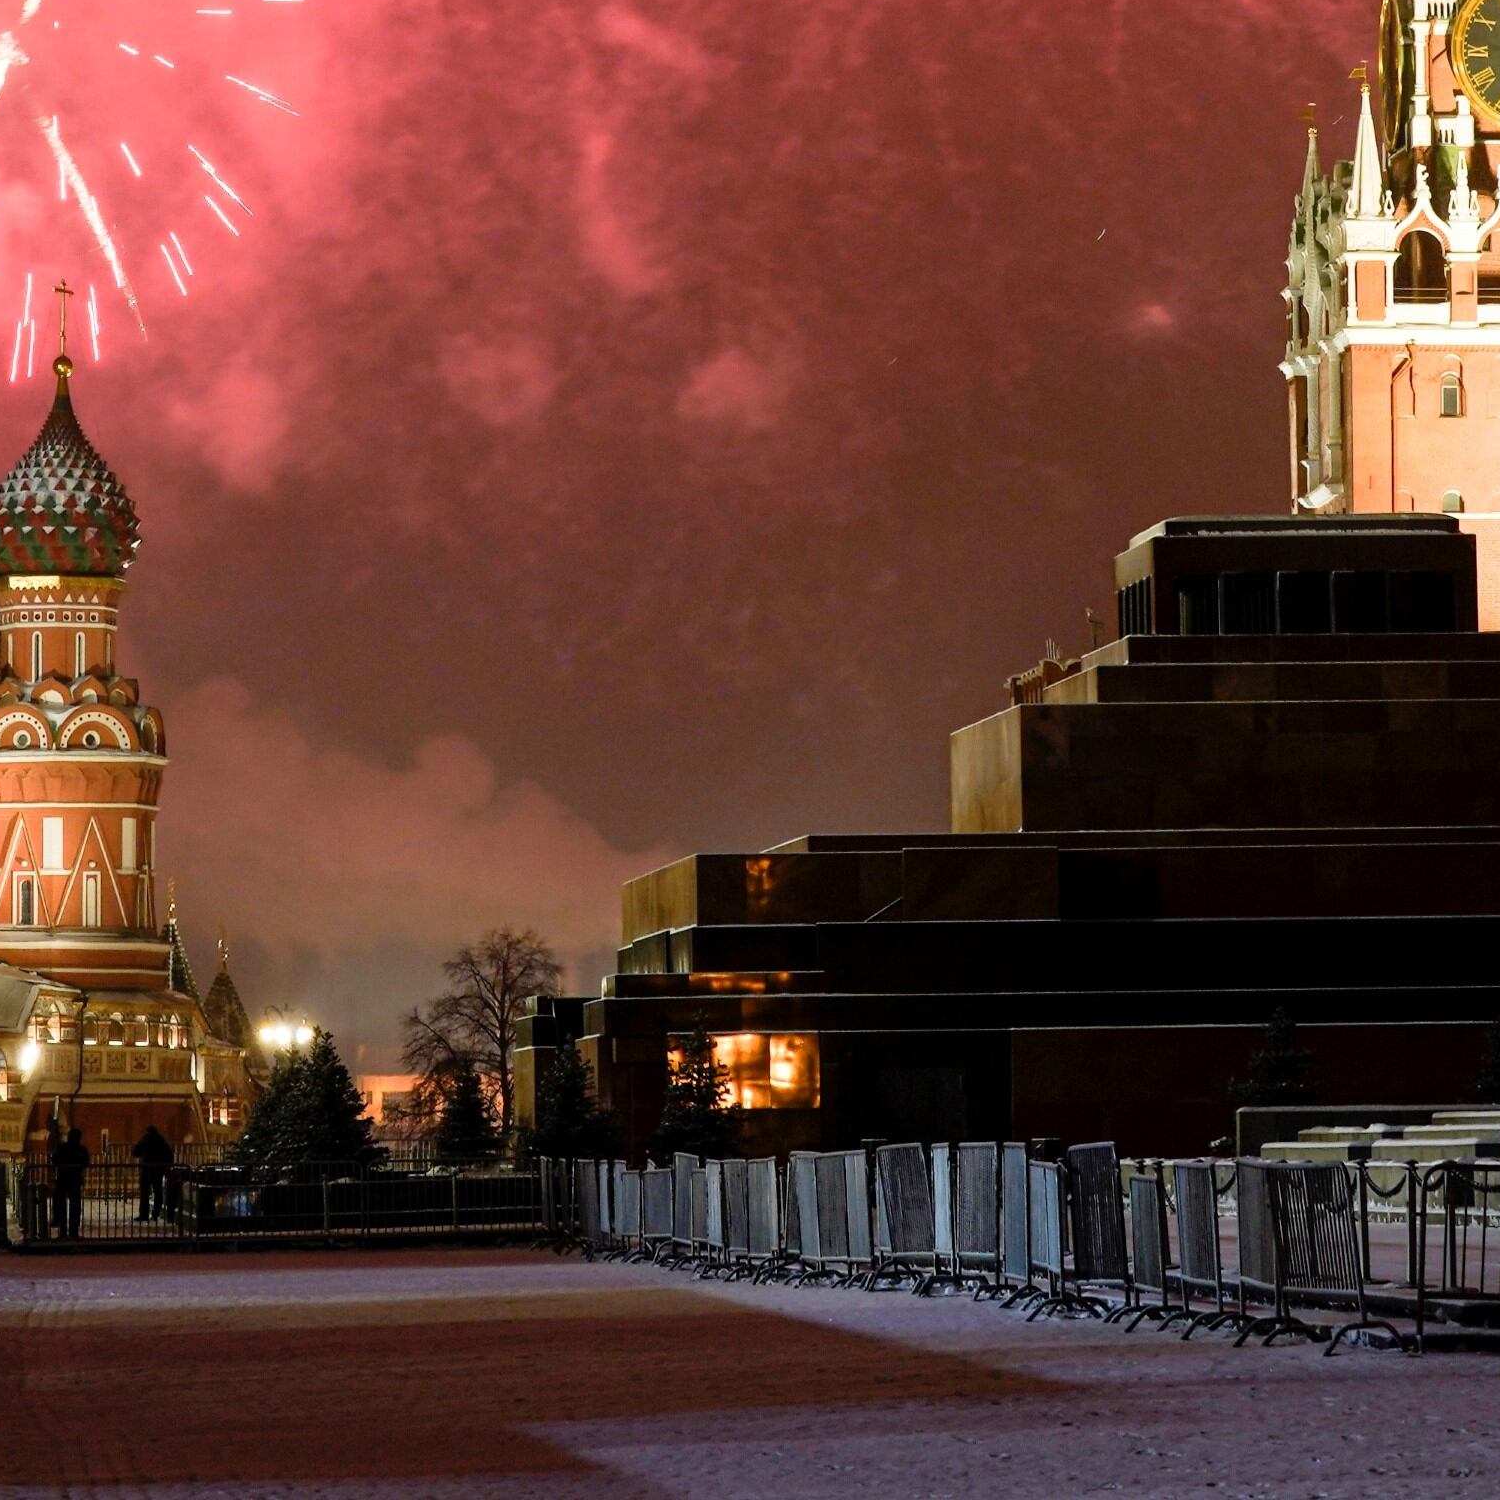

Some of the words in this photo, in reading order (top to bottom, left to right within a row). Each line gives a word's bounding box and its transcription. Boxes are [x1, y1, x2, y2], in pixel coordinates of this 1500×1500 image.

[1474, 12, 1497, 32] X
[1467, 44, 1489, 58] IX
[1472, 66, 1497, 93] VIII
